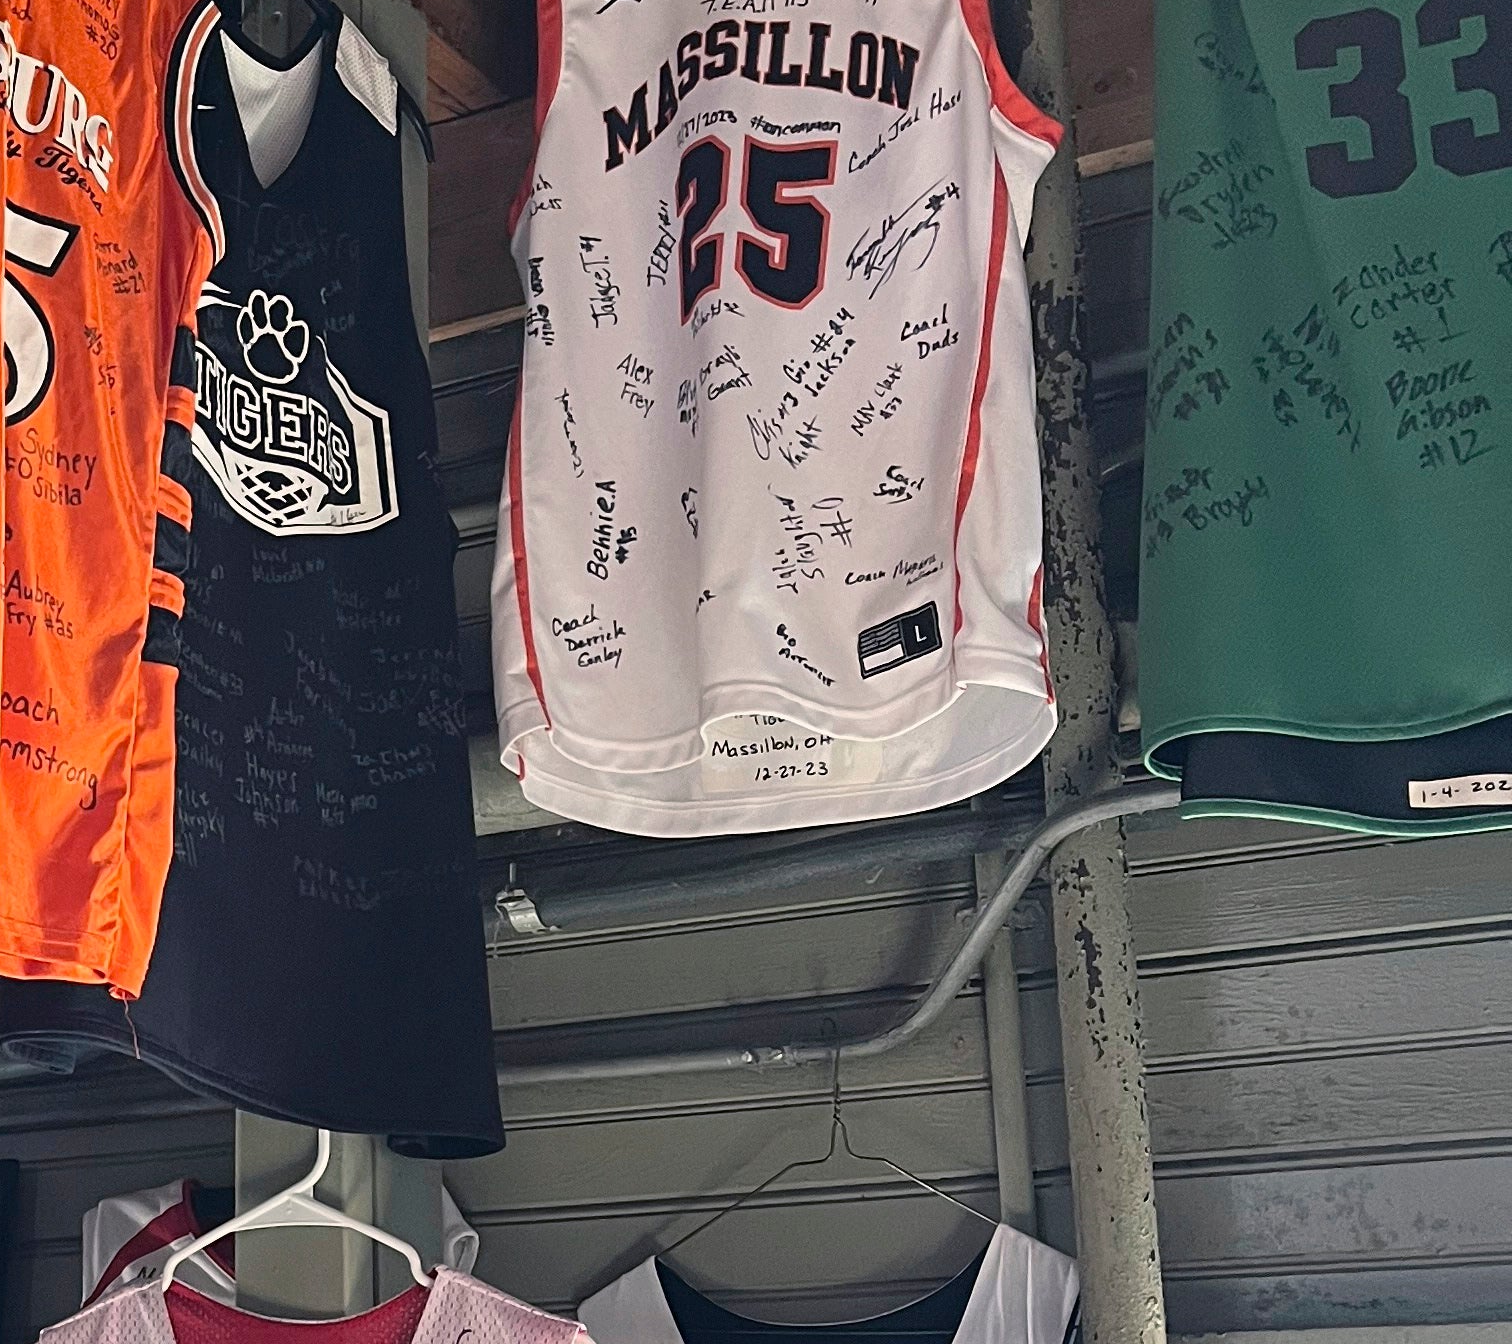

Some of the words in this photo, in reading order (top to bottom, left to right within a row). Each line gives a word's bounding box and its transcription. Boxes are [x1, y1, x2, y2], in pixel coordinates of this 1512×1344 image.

[603, 18, 921, 173] MASSILLON
[675, 134, 839, 325] 25
[1349, 276, 1456, 330] Carter
[617, 353, 654, 385] Alex
[620, 381, 655, 419] Frey
[1396, 392, 1492, 440] Gibson
[195, 349, 353, 496] TIGERS
[21, 428, 97, 492] Sydney
[1419, 429, 1494, 470] #12
[5, 570, 65, 618] Aubrey
[6, 602, 37, 636] Fry
[552, 603, 600, 636] Coach
[564, 619, 626, 653] Derrick
[914, 625, 927, 643] L
[0, 688, 59, 726] oach
[0, 738, 97, 810] rmstrong
[754, 761, 829, 781] 12-27-23
